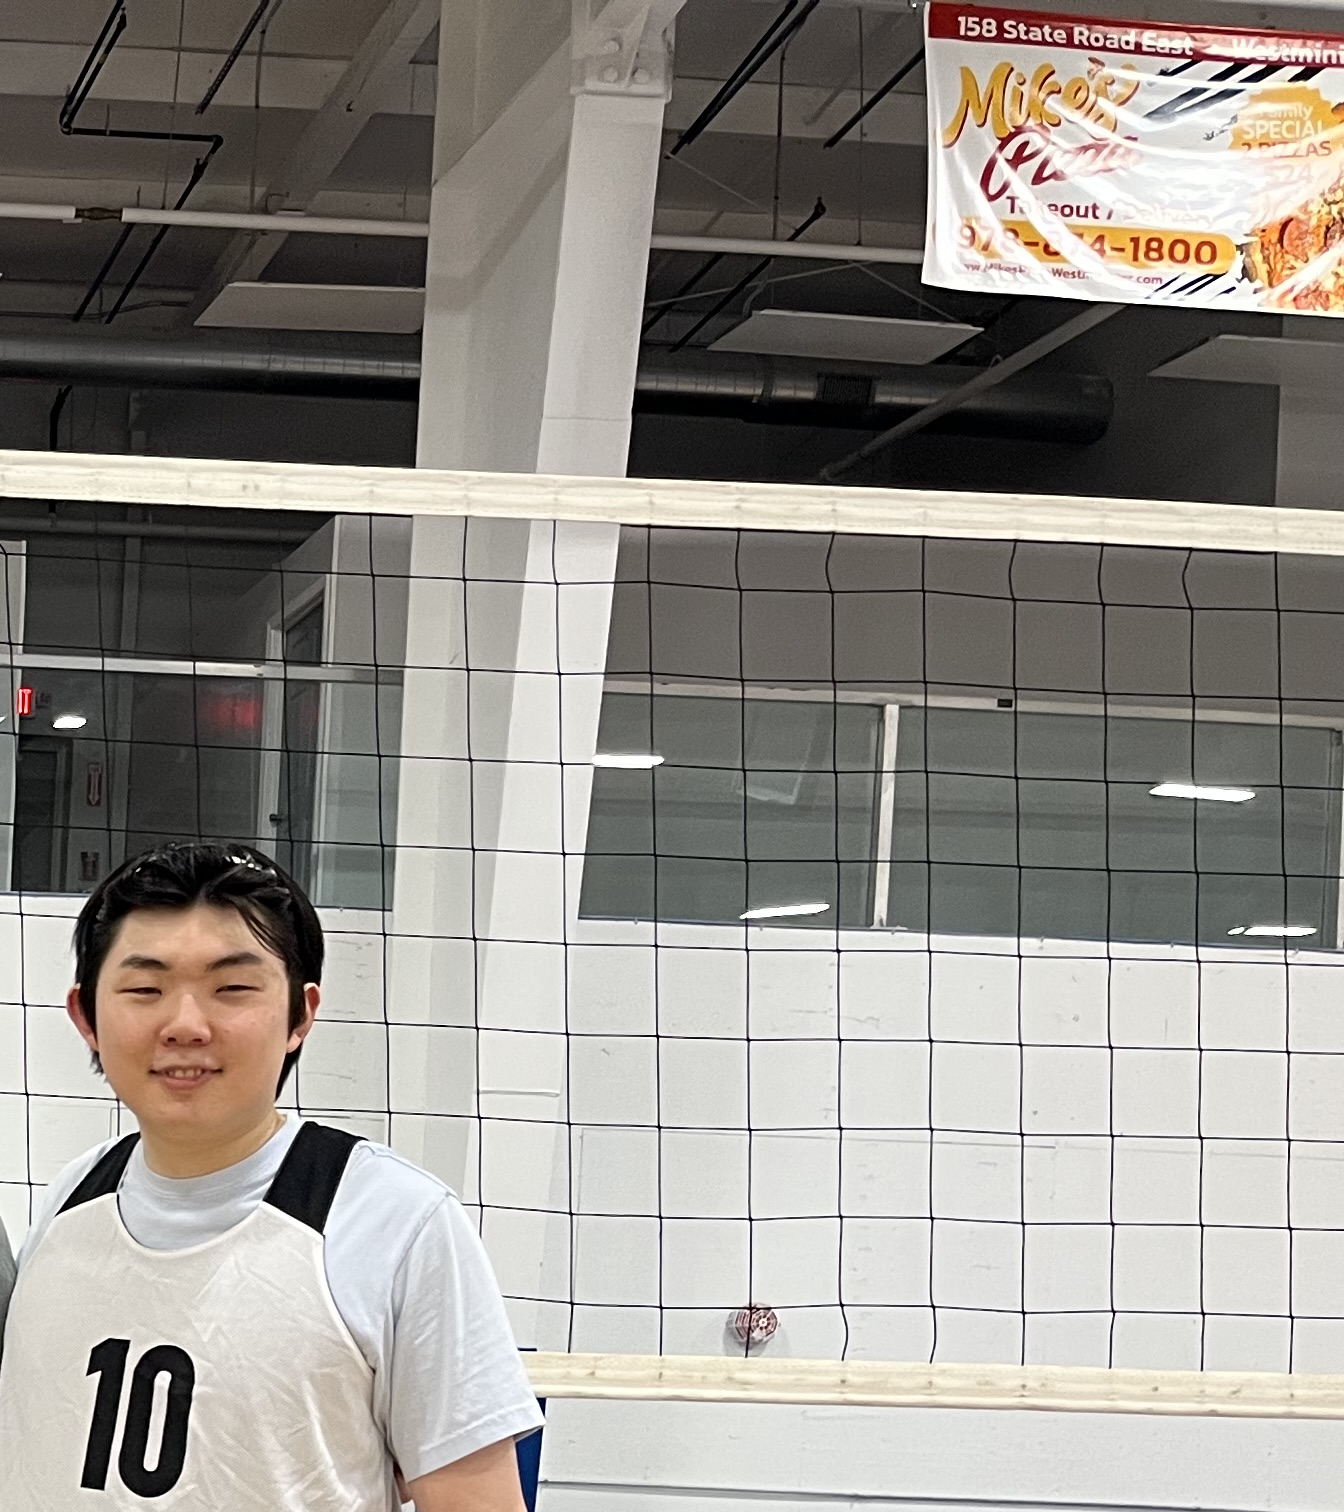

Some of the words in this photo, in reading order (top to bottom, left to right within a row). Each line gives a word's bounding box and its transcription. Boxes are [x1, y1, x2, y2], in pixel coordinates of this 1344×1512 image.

[958, 15, 998, 38] 158
[1003, 20, 1067, 44] State
[1073, 26, 1136, 50] Road
[1141, 31, 1194, 56] East
[1006, 195, 1100, 220] Taeout
[80, 1337, 195, 1498] 10
